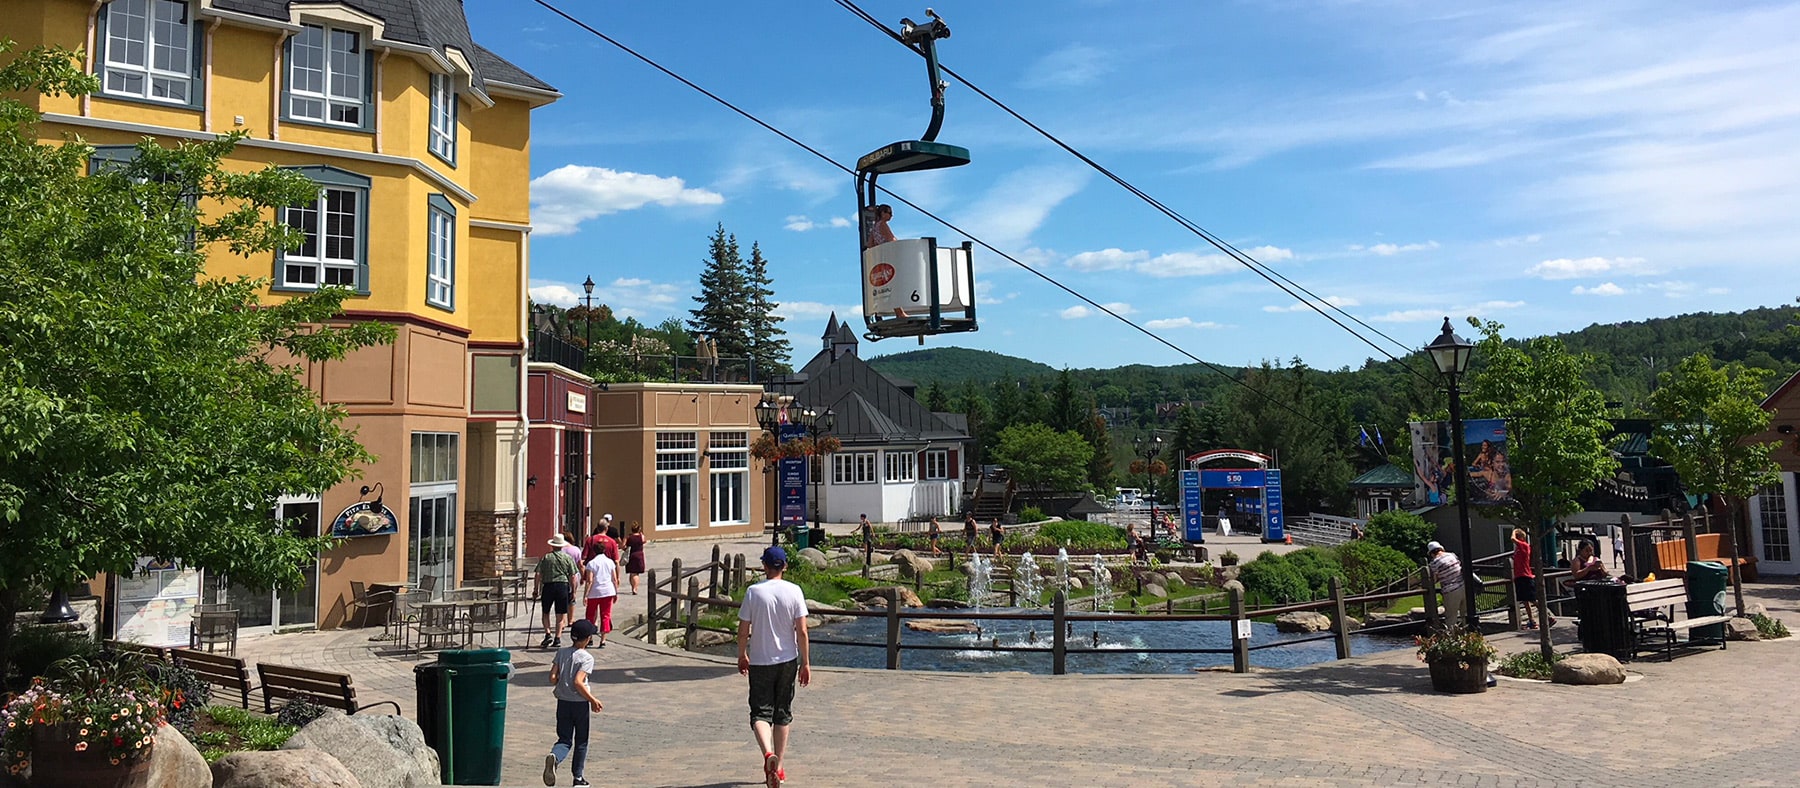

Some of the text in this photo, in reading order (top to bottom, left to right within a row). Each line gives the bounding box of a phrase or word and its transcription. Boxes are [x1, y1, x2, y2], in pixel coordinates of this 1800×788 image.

[910, 289, 920, 302] 6
[345, 506, 360, 516] PITA
[1190, 517, 1197, 525] G
[1271, 516, 1278, 524] G
